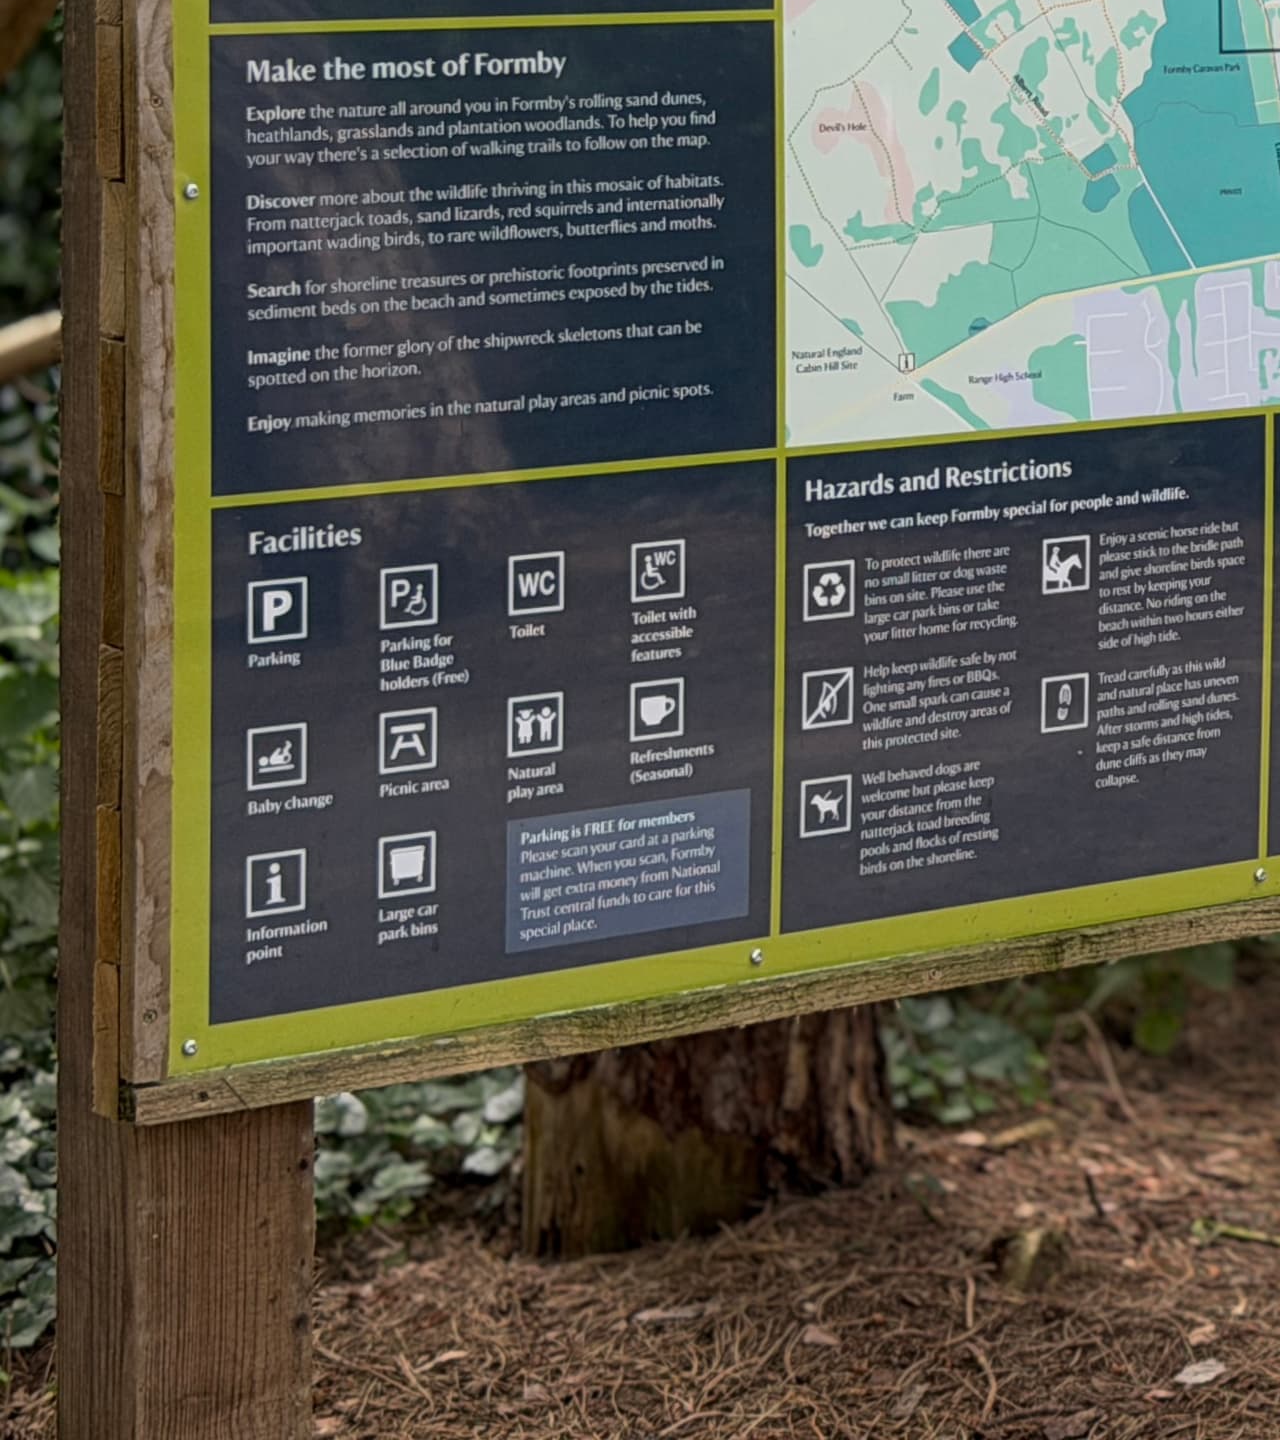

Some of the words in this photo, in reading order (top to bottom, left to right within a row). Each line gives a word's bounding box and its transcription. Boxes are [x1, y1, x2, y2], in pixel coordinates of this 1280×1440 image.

[246, 58, 316, 83] Make
[323, 56, 366, 81] the
[372, 58, 436, 79] most
[441, 52, 471, 77] of
[474, 51, 566, 78] Formby
[968, 375, 992, 386] Range
[995, 372, 1014, 383] High
[1015, 370, 1042, 381] School
[805, 473, 895, 501] Hazards
[899, 467, 940, 493] and
[945, 460, 1073, 488] Restrictions
[804, 521, 867, 539] Together
[867, 519, 888, 531] we
[889, 516, 914, 529] can
[916, 512, 949, 527] keep
[951, 505, 1000, 522] Formby
[1002, 500, 1047, 520] special
[1049, 498, 1069, 513] for
[1070, 494, 1114, 514] people
[1115, 490, 1139, 506] and
[1141, 486, 1190, 503] wildlife.
[249, 524, 362, 554] Facilities
[654, 549, 676, 566] WC
[390, 578, 411, 608] P
[518, 570, 556, 597] WC
[262, 589, 293, 632] P
[631, 610, 666, 625] Toilet
[668, 606, 697, 621] with
[509, 623, 545, 639] Toilet
[630, 625, 694, 644] accessible
[380, 637, 432, 653] Parking
[433, 633, 453, 647] for
[248, 651, 301, 668] Parking
[380, 658, 410, 673] Blue
[412, 653, 454, 669] Badge
[631, 647, 682, 662] features
[380, 675, 430, 691] holders
[431, 669, 470, 687] (Free)
[630, 745, 715, 764] Refreshments
[507, 762, 556, 780] Natural
[630, 763, 693, 784] (Seasonal)
[379, 780, 419, 798] Picnic
[421, 779, 450, 793] area
[507, 785, 535, 803] play
[535, 783, 564, 796] area
[247, 799, 282, 815] Baby
[284, 794, 333, 810] change
[521, 828, 569, 845] Parking
[571, 825, 582, 838] is
[584, 819, 615, 836] FREE
[618, 818, 637, 831] for
[638, 811, 696, 828] members
[378, 908, 415, 923] Large
[417, 904, 439, 917] car
[246, 920, 328, 942] Information
[377, 925, 409, 945] park
[410, 922, 439, 937] bins
[246, 945, 283, 965] point
